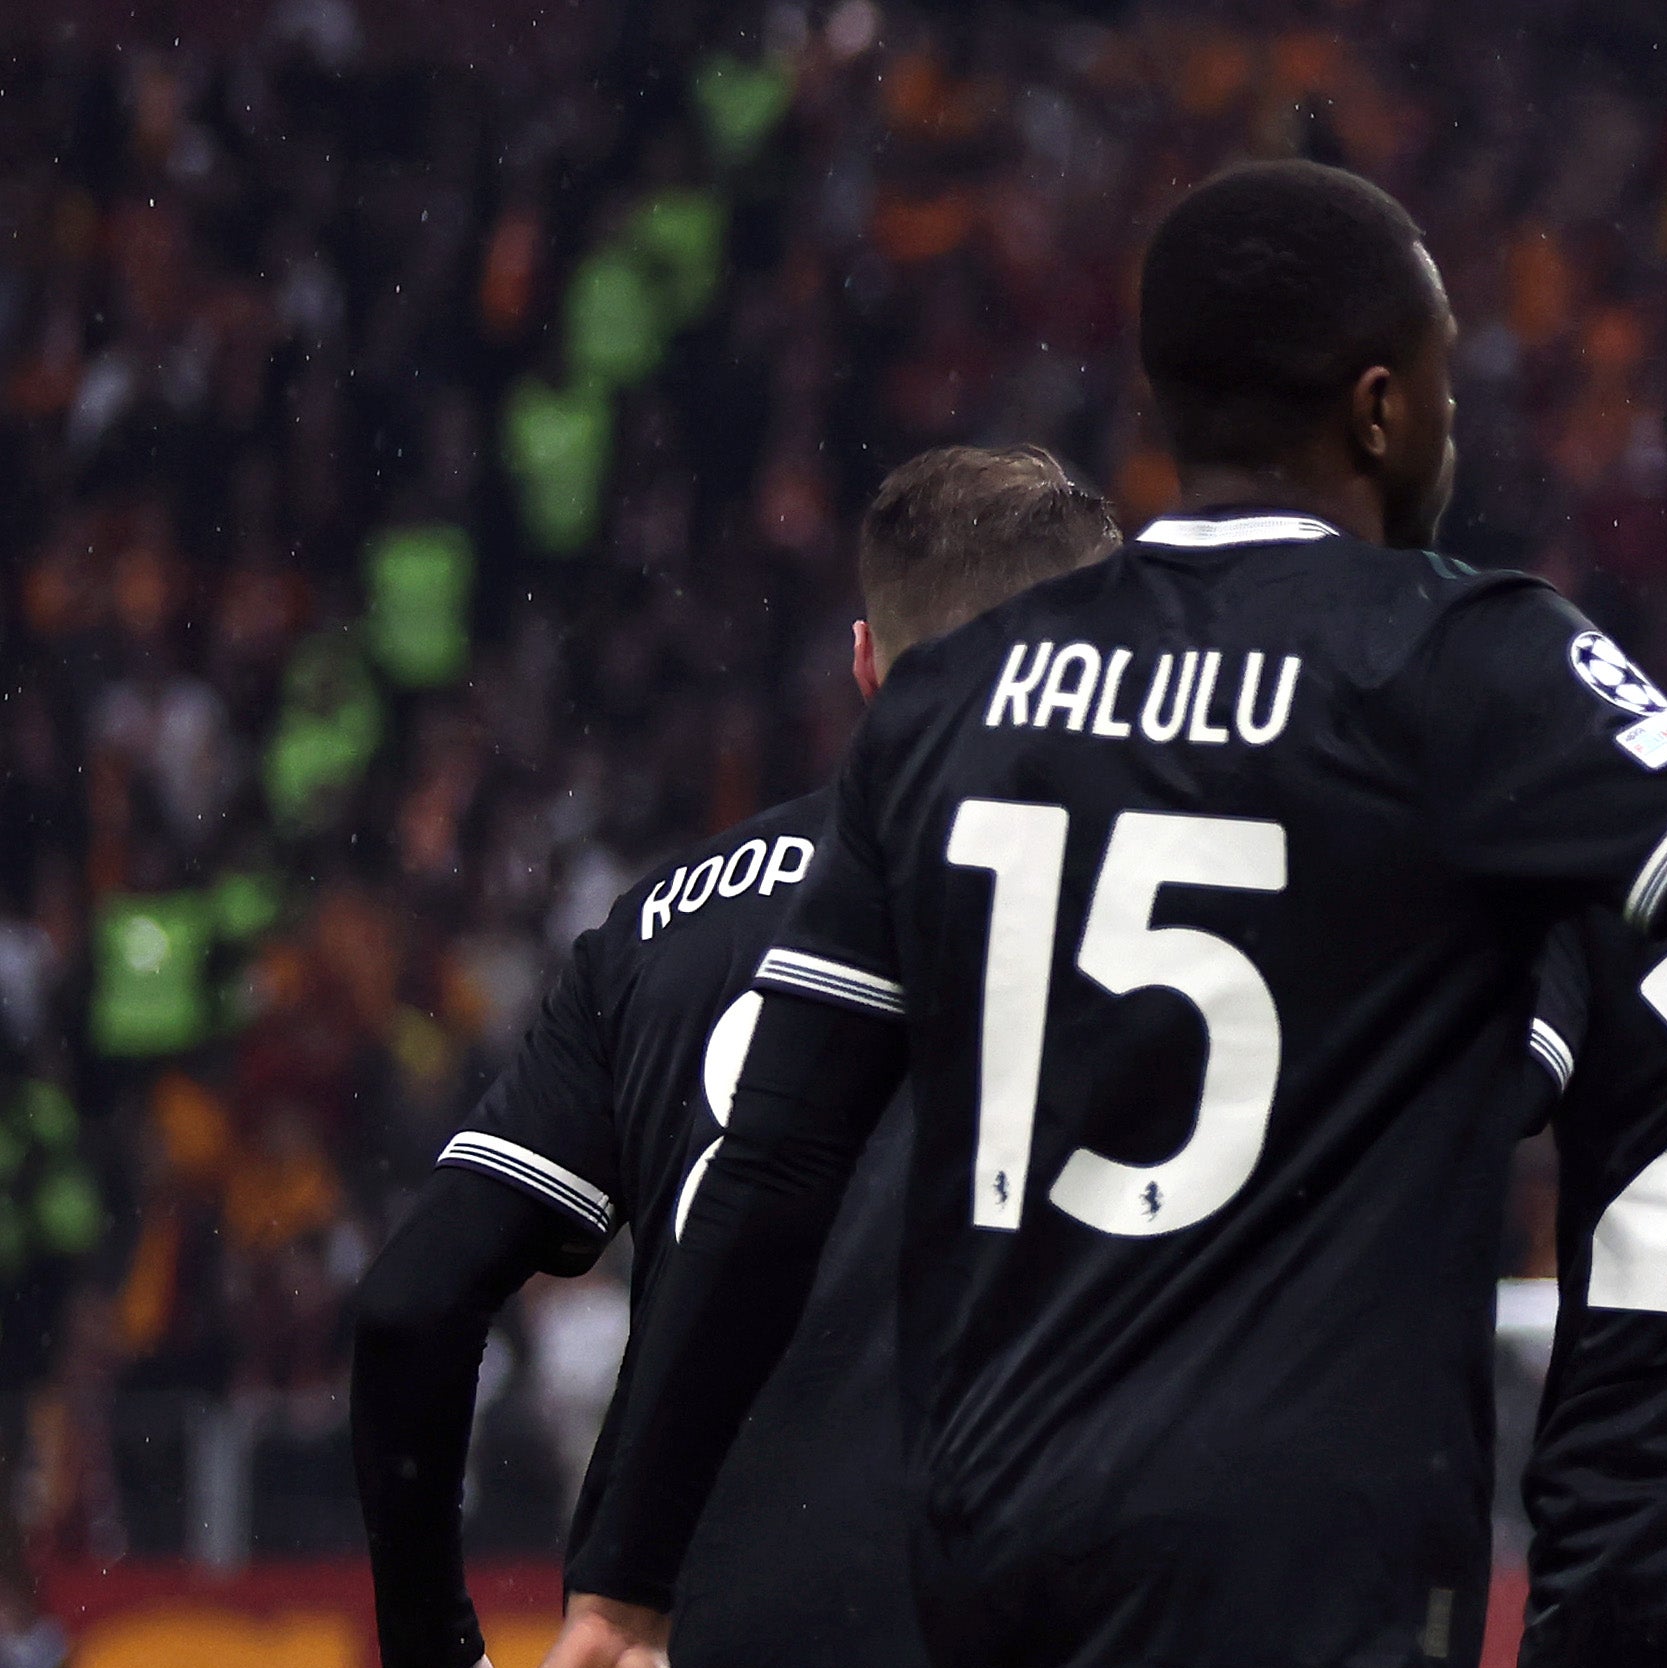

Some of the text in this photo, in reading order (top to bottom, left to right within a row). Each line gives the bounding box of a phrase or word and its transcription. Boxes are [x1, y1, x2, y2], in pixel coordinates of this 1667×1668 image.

[985, 641, 1302, 745] KALULU
[641, 835, 815, 941] KOOP
[946, 799, 1287, 1236] 15
